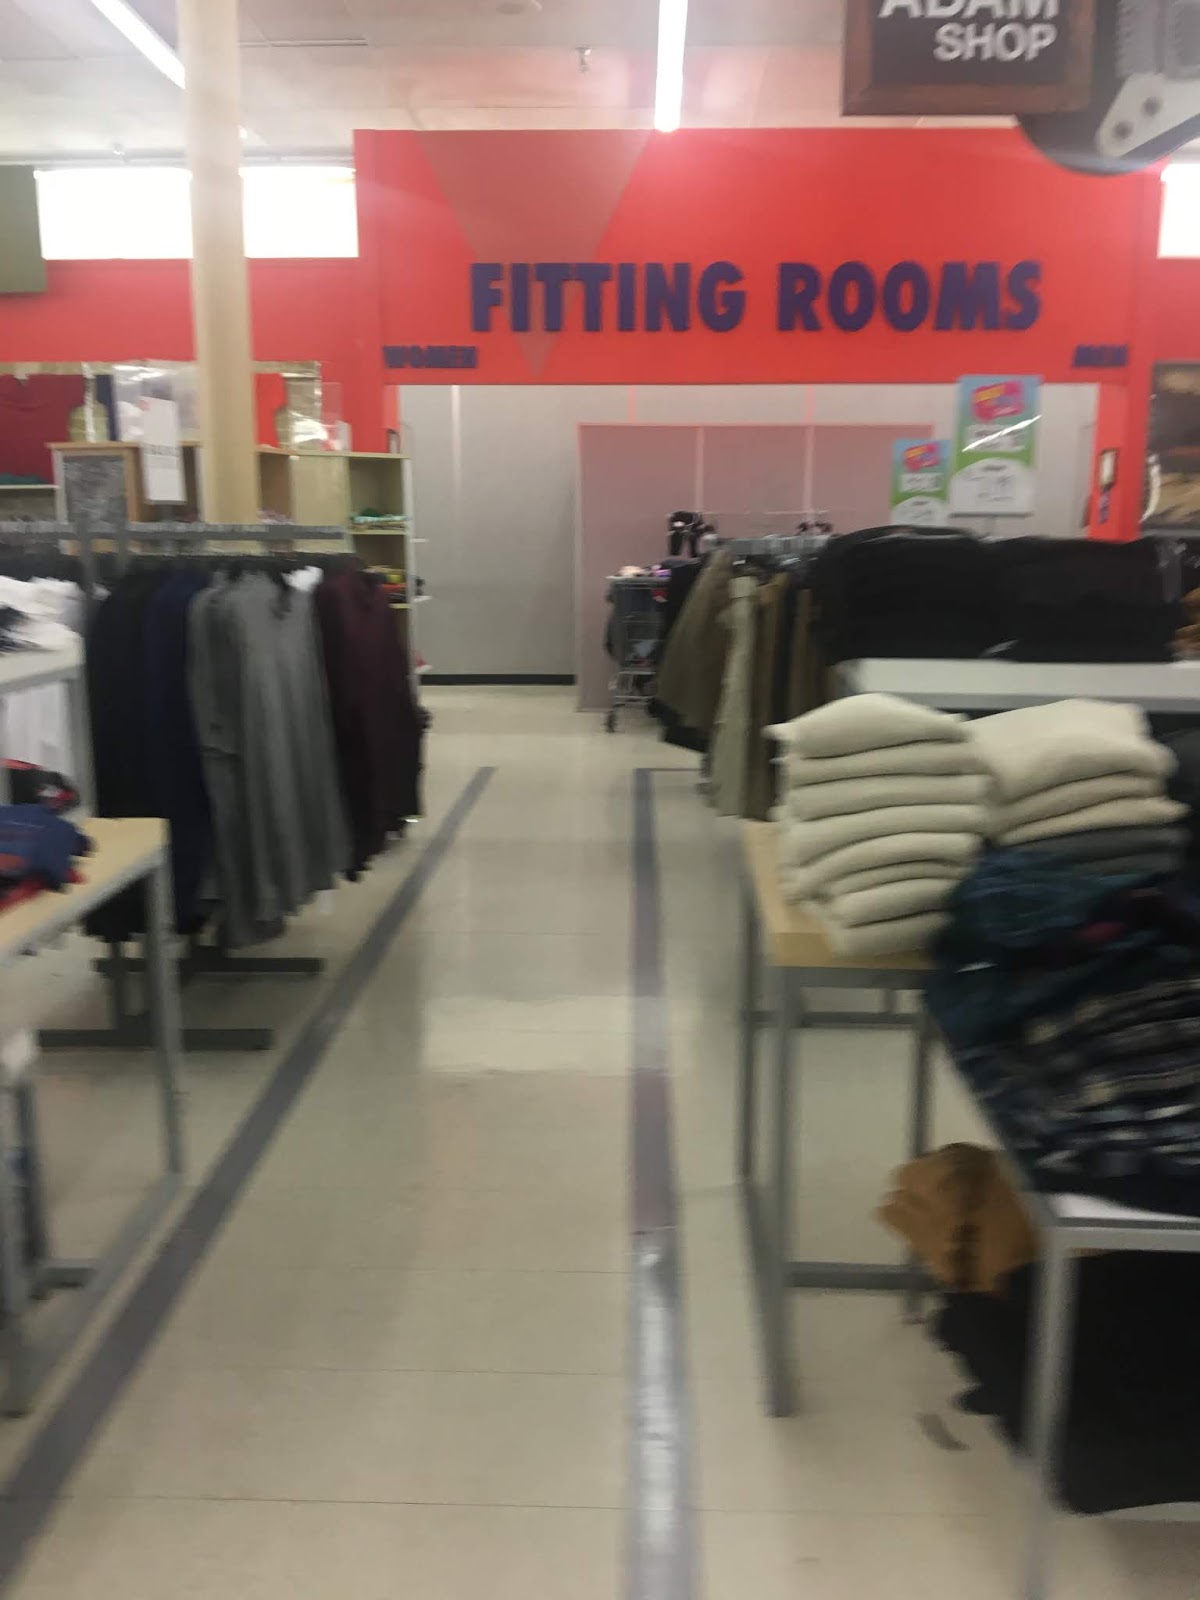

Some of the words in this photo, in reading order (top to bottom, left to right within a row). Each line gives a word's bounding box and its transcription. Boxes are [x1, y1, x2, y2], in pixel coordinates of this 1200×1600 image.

[934, 22, 1058, 61] SHOP
[471, 261, 746, 332] FITTING
[778, 261, 1042, 332] ROOMS
